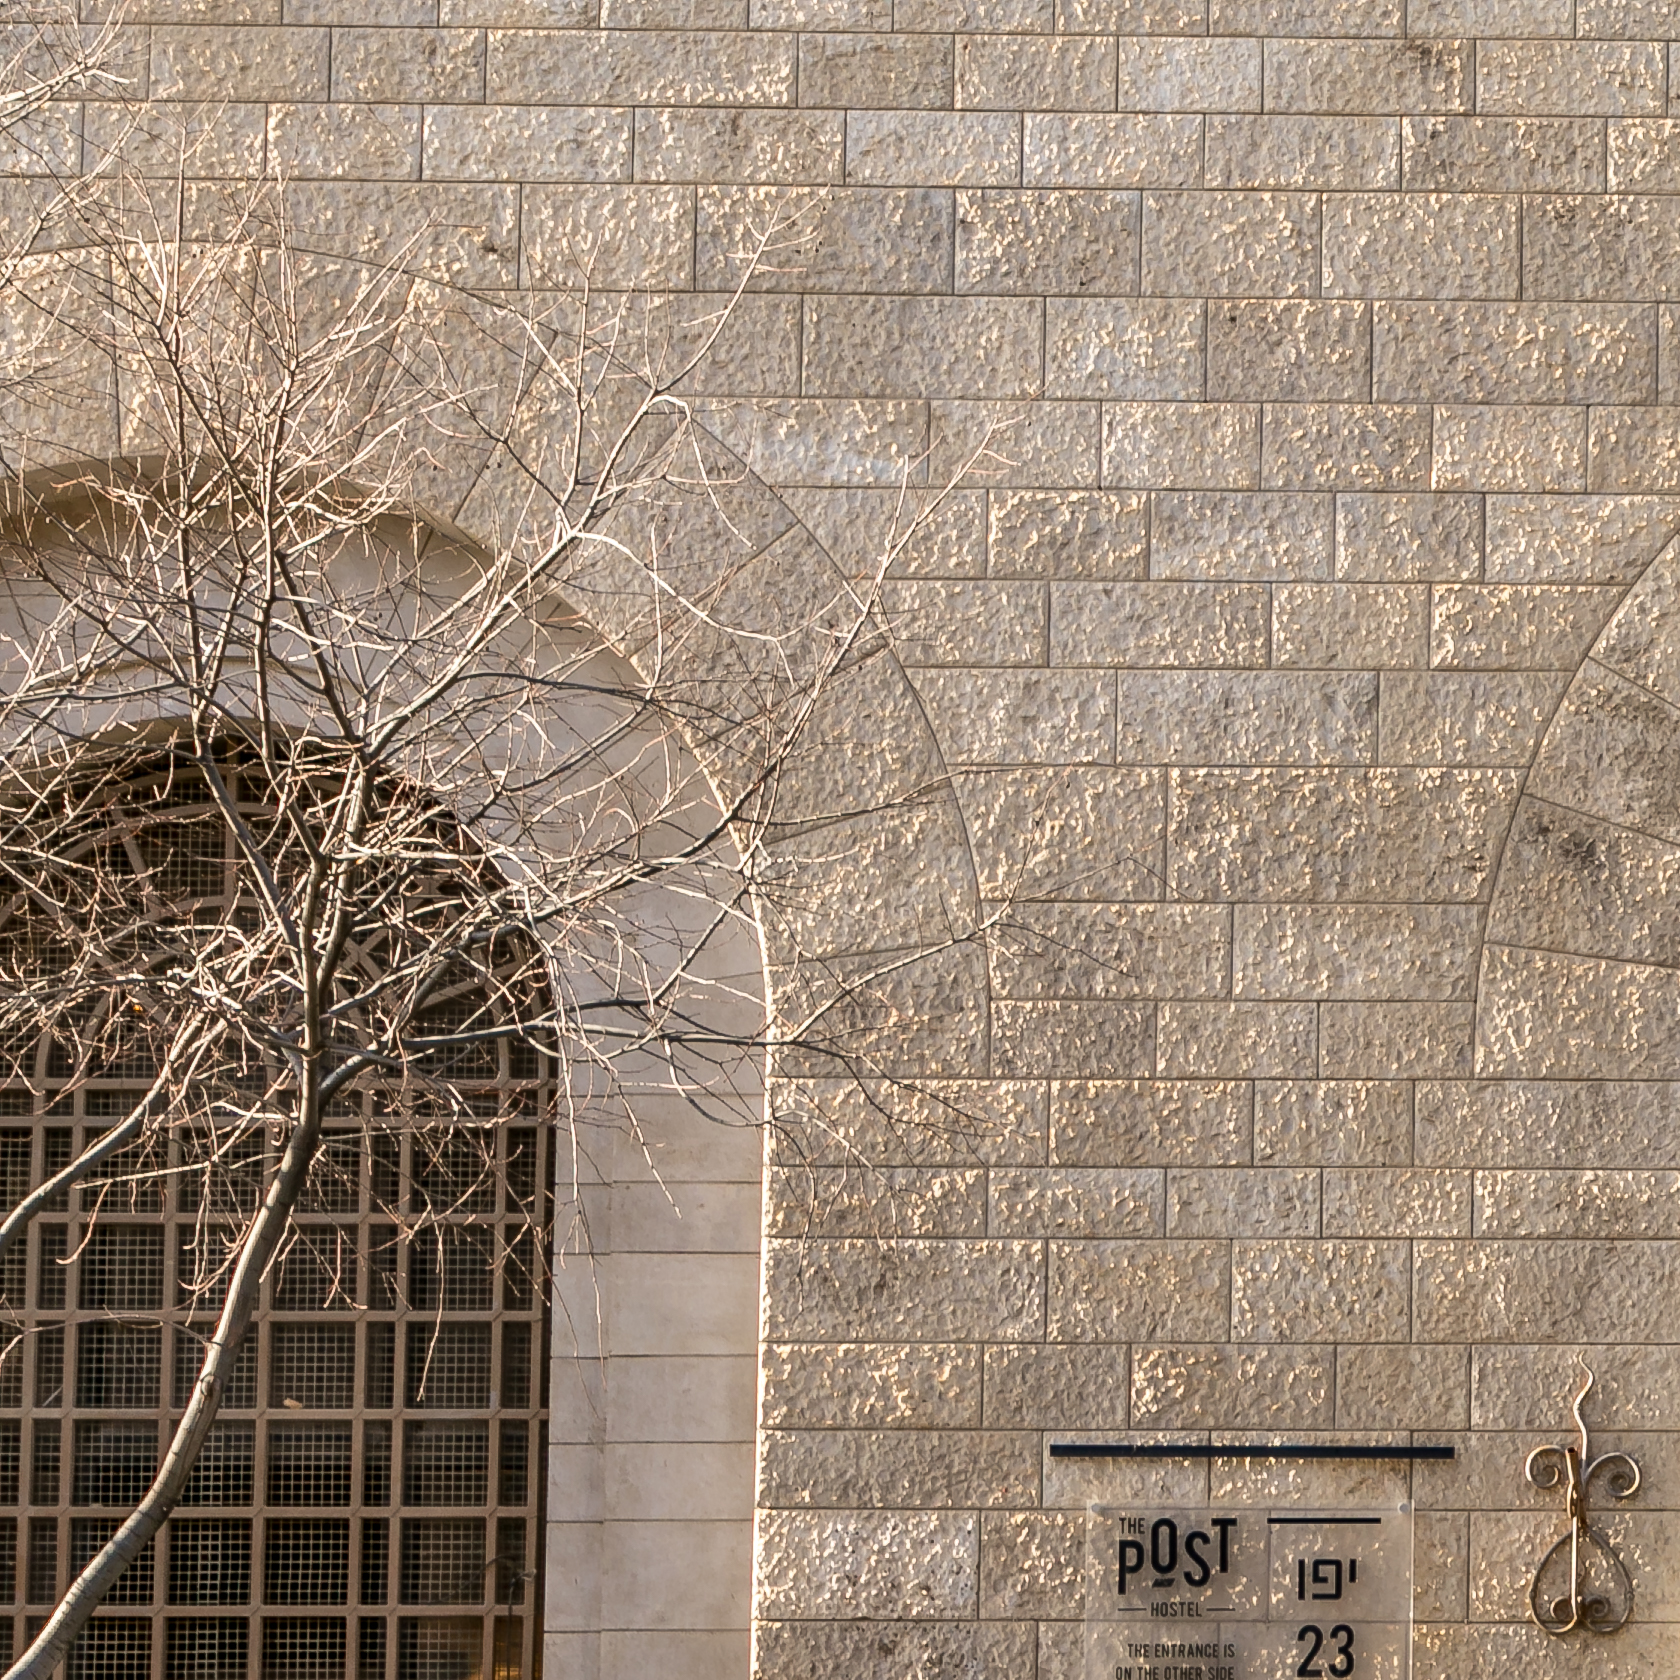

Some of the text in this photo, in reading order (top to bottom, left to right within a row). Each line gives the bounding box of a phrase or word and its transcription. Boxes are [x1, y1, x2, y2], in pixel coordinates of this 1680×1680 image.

[1119, 1517, 1145, 1534] THE
[1118, 1518, 1237, 1595] POST
[1298, 1558, 1357, 1600] יפו
[1150, 1601, 1203, 1617] HOSTEL
[1127, 1643, 1235, 1658] THE ENTRANCE IS
[1297, 1624, 1355, 1679] 23
[1115, 1666, 1235, 1680] ON THE OTHER SIDE
